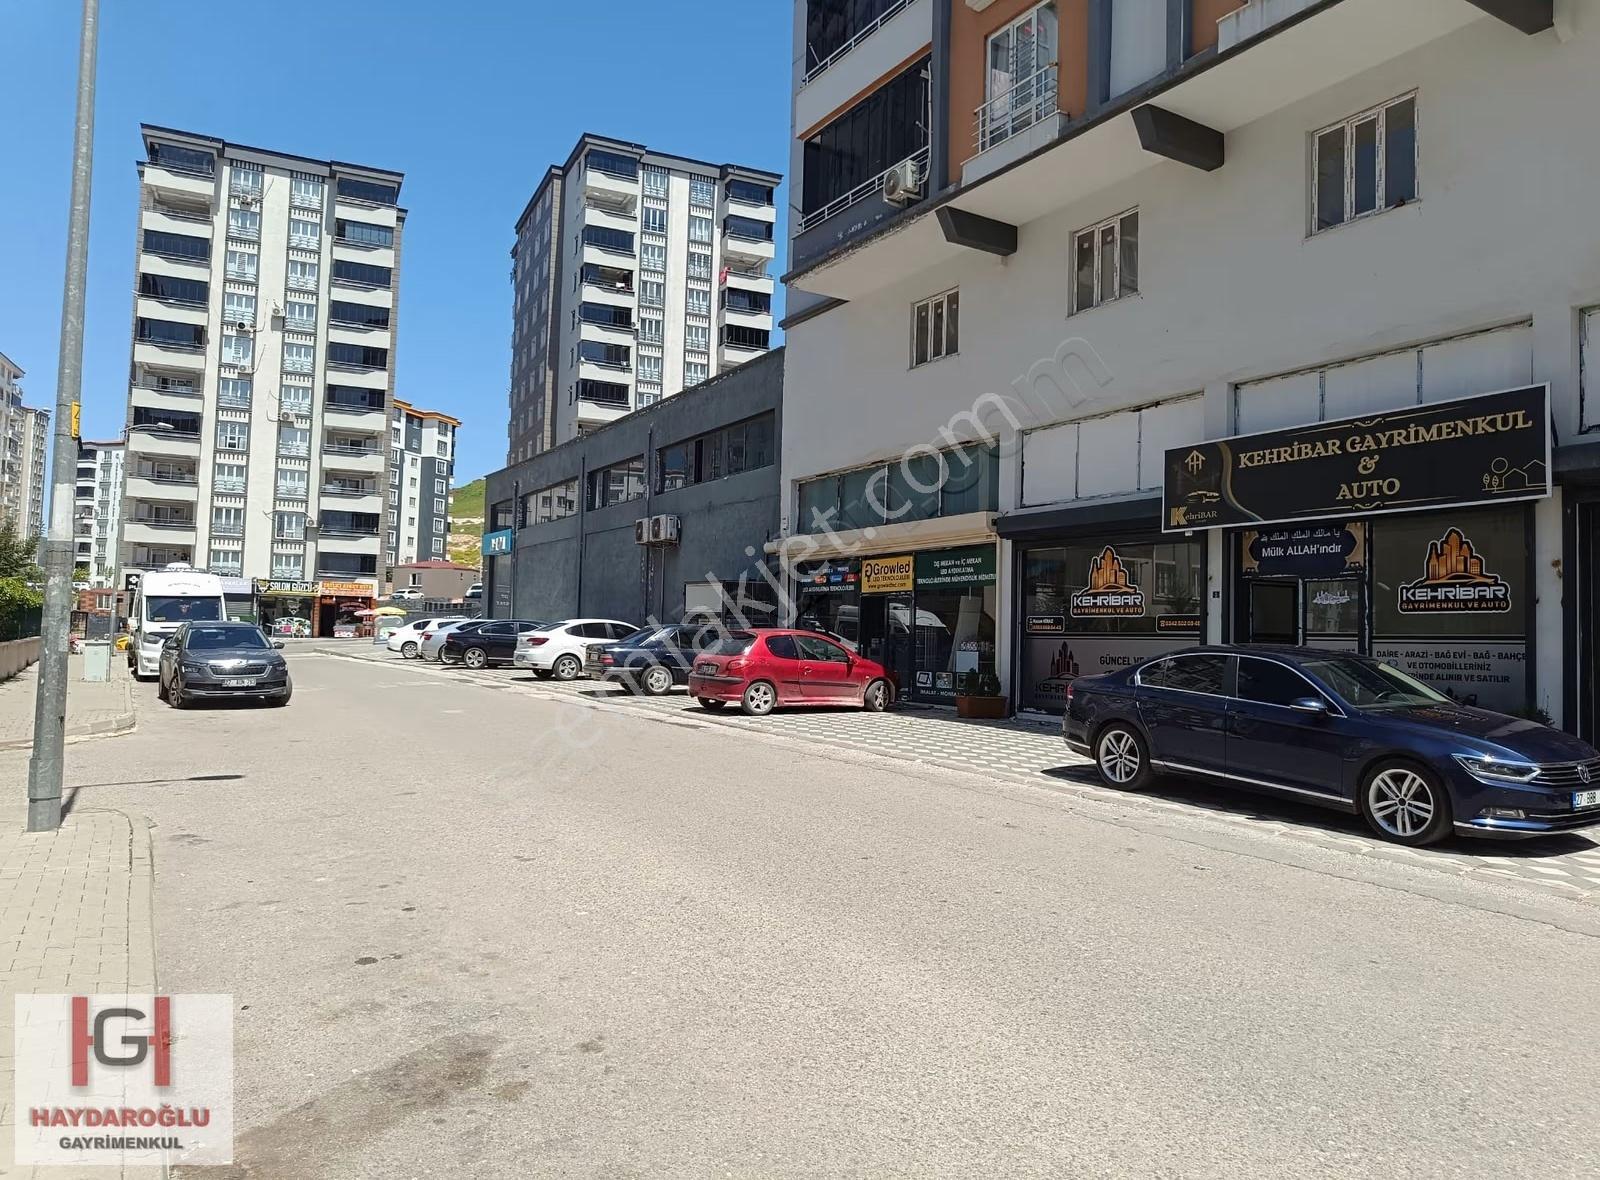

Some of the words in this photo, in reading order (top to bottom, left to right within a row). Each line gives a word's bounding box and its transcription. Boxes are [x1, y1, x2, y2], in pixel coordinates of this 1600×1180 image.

[1238, 439, 1342, 469] KEHRİBAR
[1345, 410, 1533, 455] GAYRİMENKUL
[1357, 455, 1381, 475] &
[1335, 477, 1401, 501] AUTO
[1262, 546, 1284, 557] Mülk
[873, 561, 910, 575] Growled
[1402, 585, 1505, 600] KEHRİBAR
[1073, 593, 1142, 606] KEHRİBAR
[1401, 600, 1465, 609] GAYRİMENKUL
[1099, 654, 1131, 666] GÜNCEL
[1376, 650, 1399, 658] DAİRE
[1405, 650, 1428, 659] ARAZİ
[1434, 649, 1451, 660] BAĞ
[1453, 650, 1466, 660] EVİ
[1473, 650, 1490, 660] BAĞ
[1407, 661, 1417, 669] VE
[1418, 661, 1491, 672] OTOMOBİLLERİNİZ
[1435, 673, 1462, 682] ALINIR
[1464, 674, 1475, 682] VE
[1476, 674, 1510, 684] SATILIR
